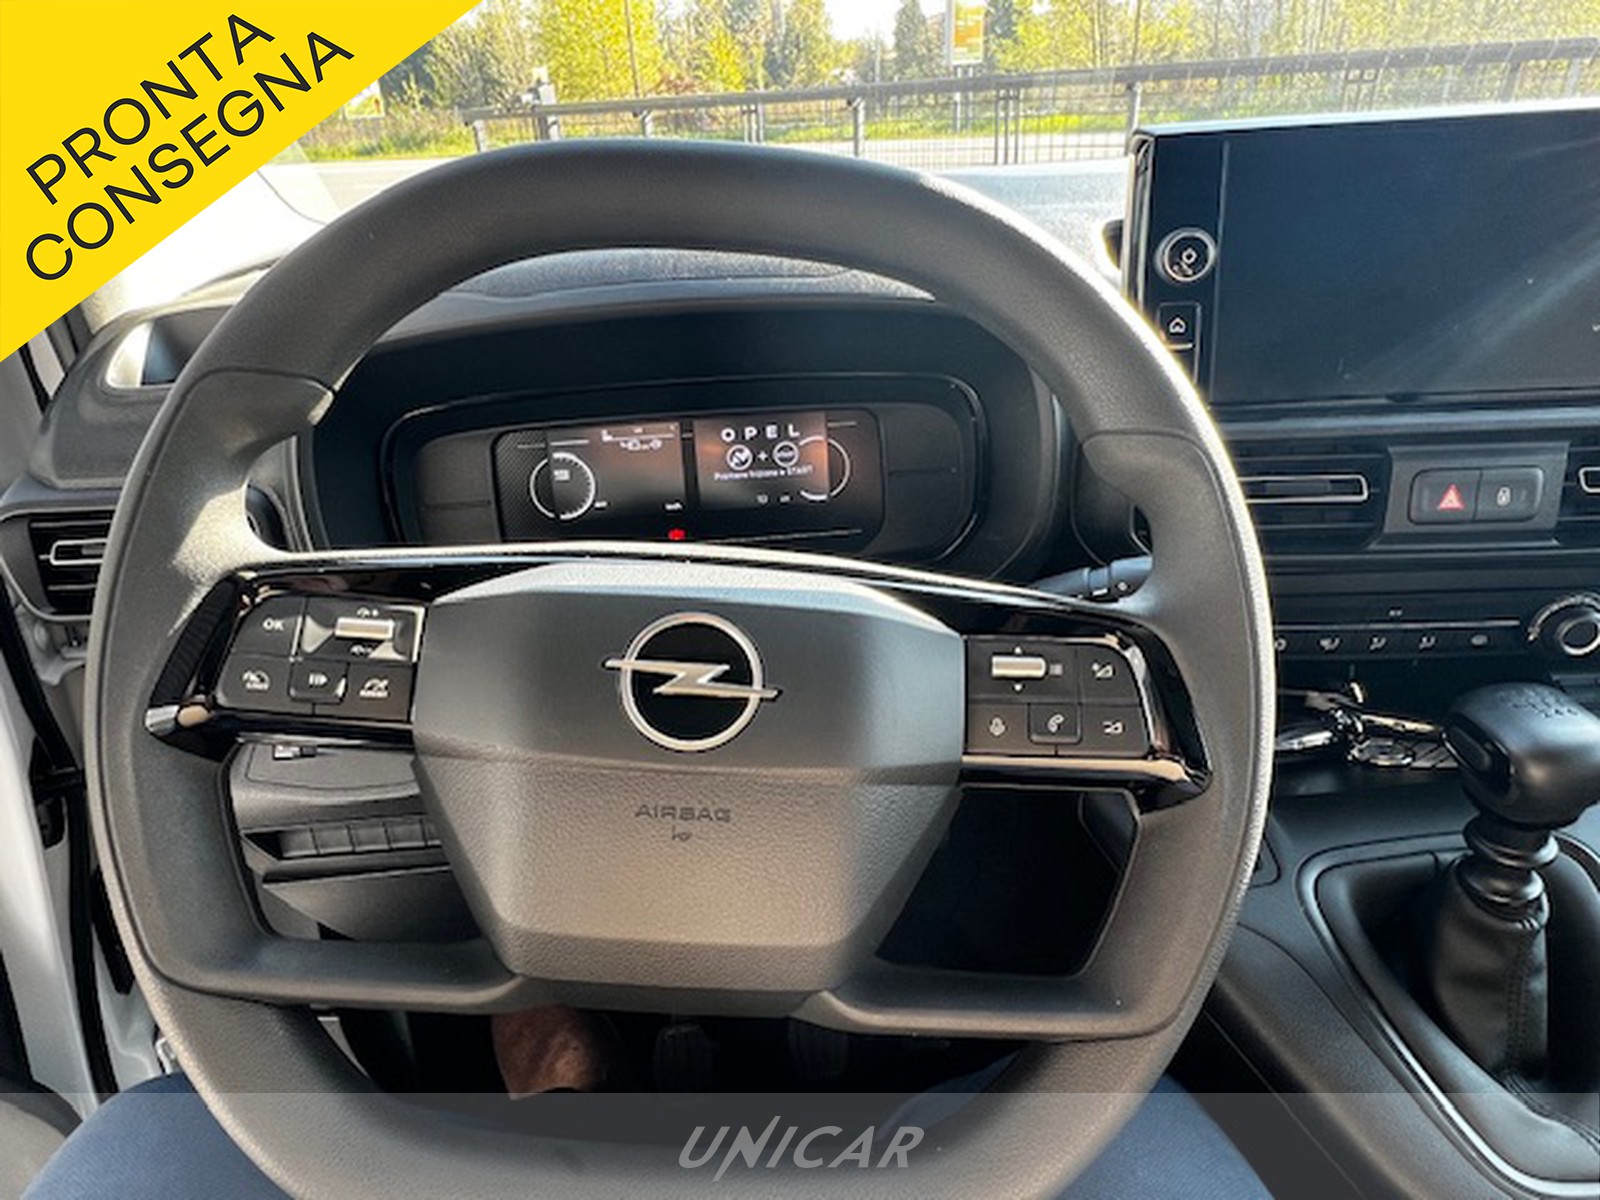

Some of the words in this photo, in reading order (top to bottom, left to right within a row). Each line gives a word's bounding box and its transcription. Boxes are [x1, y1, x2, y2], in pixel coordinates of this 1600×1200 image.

[721, 423, 800, 442] OPEL
[262, 617, 285, 631] OK
[635, 804, 732, 823] AIRBAG
